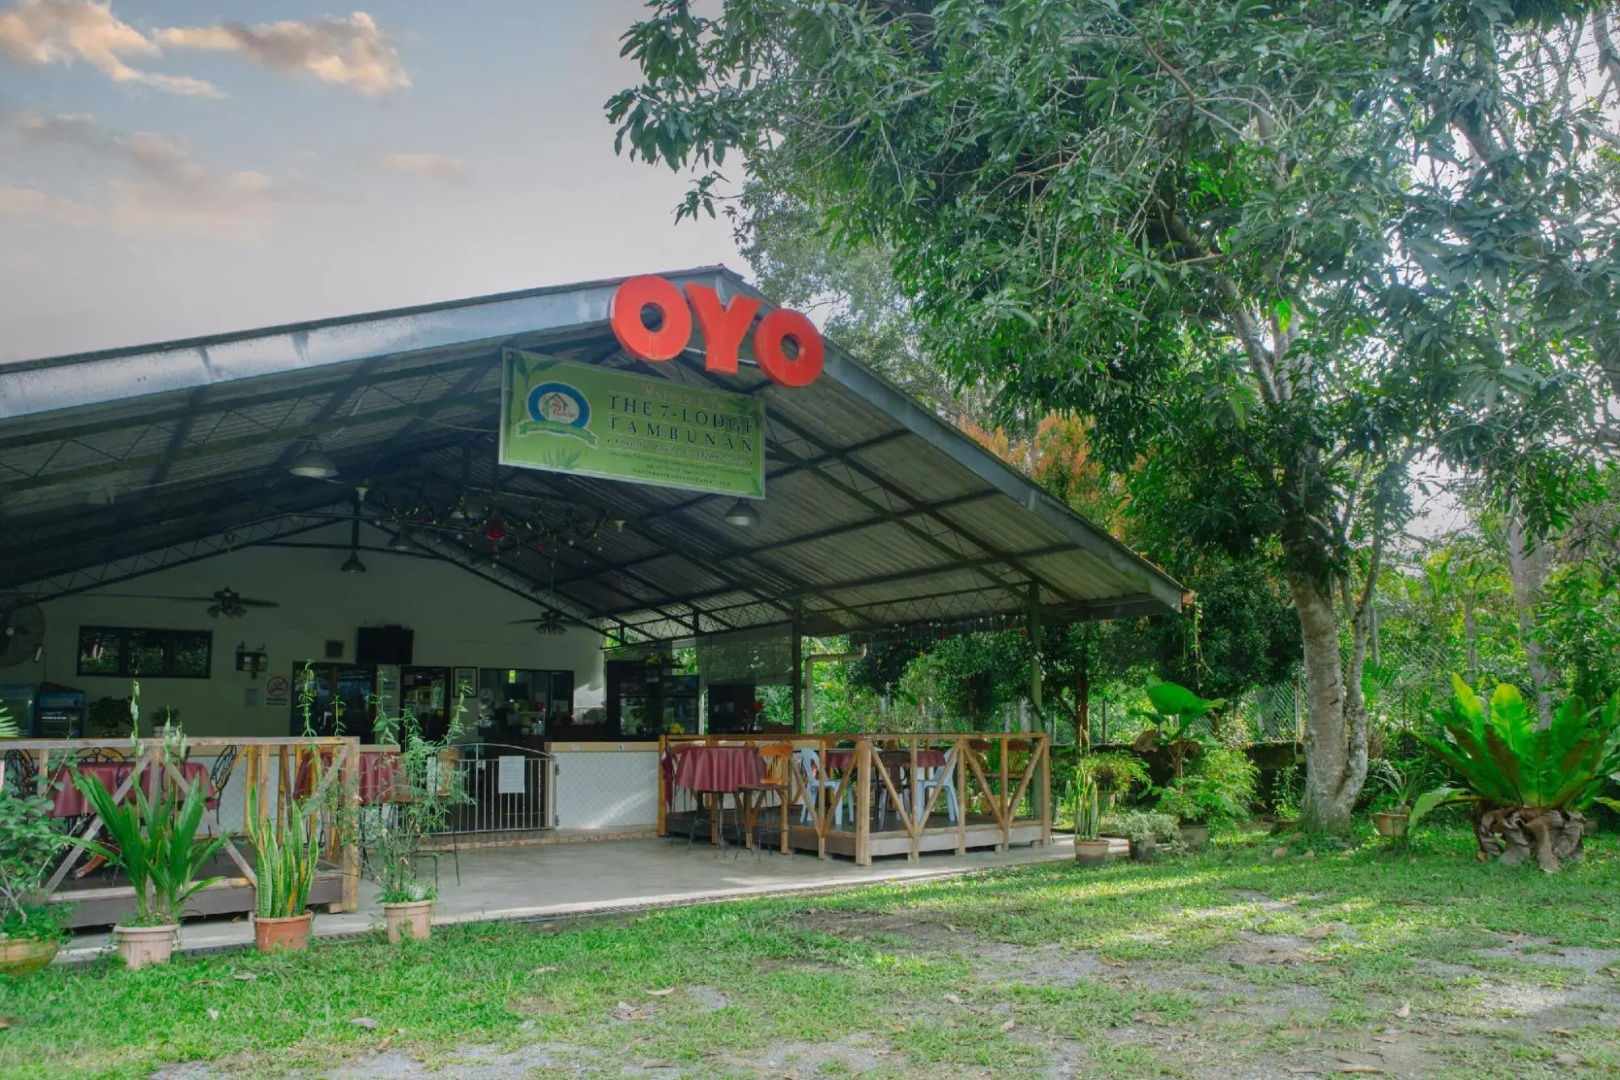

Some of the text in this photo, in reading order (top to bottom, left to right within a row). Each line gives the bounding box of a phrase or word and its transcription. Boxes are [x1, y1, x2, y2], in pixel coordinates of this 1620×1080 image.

[610, 274, 824, 387] OYO
[607, 395, 753, 434] THE 7-LODGE
[608, 417, 752, 452] TAMBUNAN
